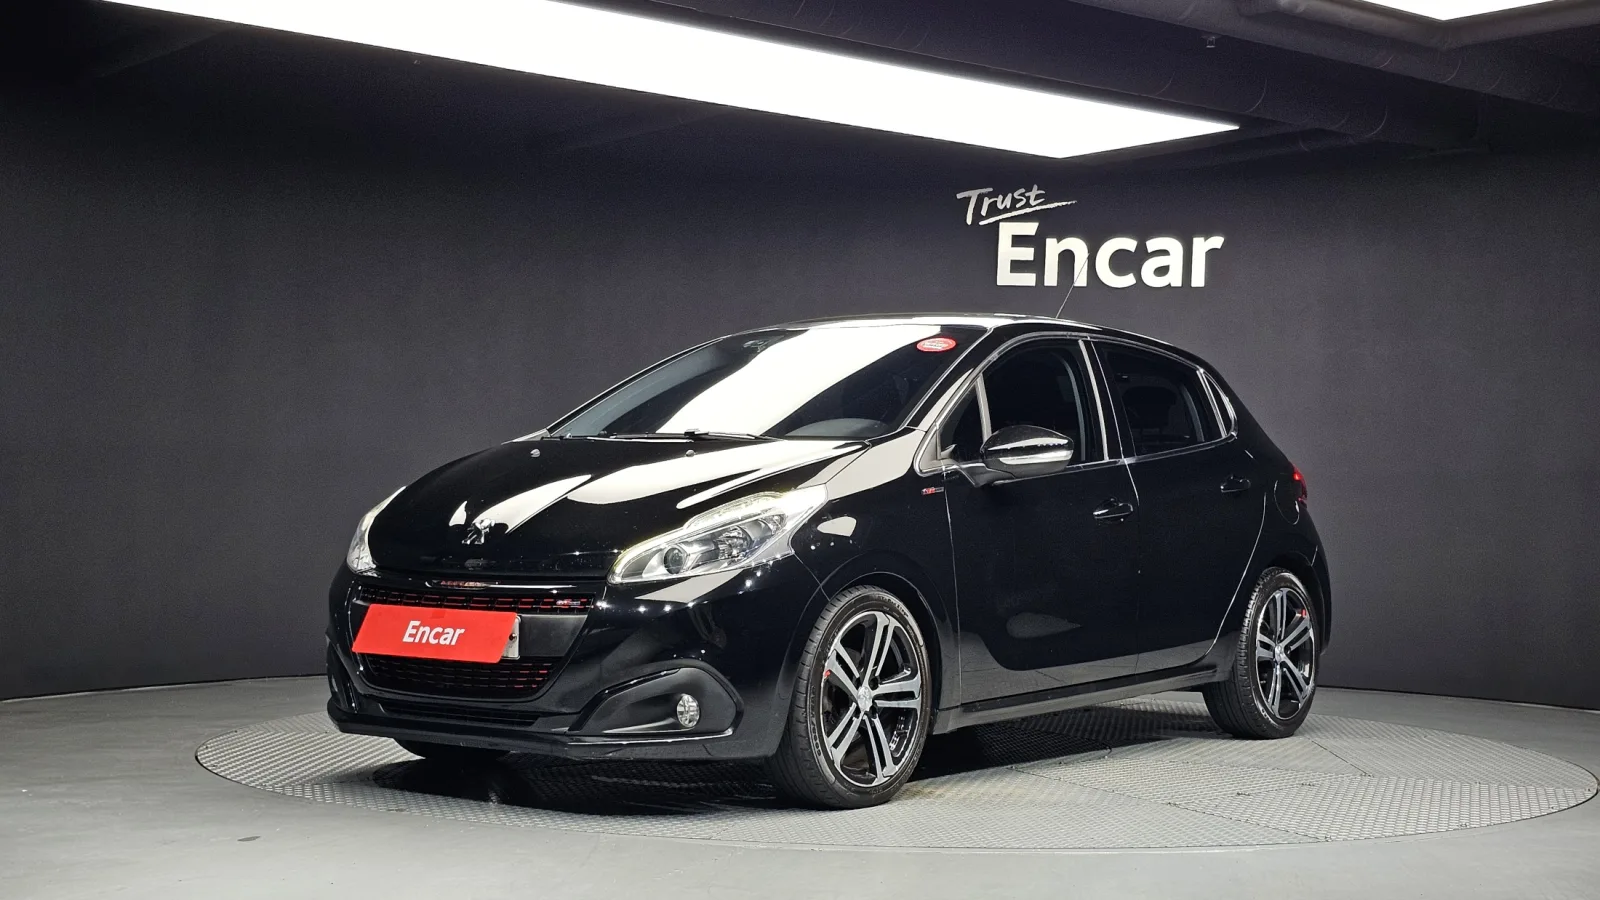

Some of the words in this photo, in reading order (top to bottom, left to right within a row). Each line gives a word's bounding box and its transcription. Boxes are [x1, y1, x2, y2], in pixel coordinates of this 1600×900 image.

[956, 184, 1046, 226] Trust
[996, 221, 1225, 289] Encar
[402, 620, 465, 646] Encar
